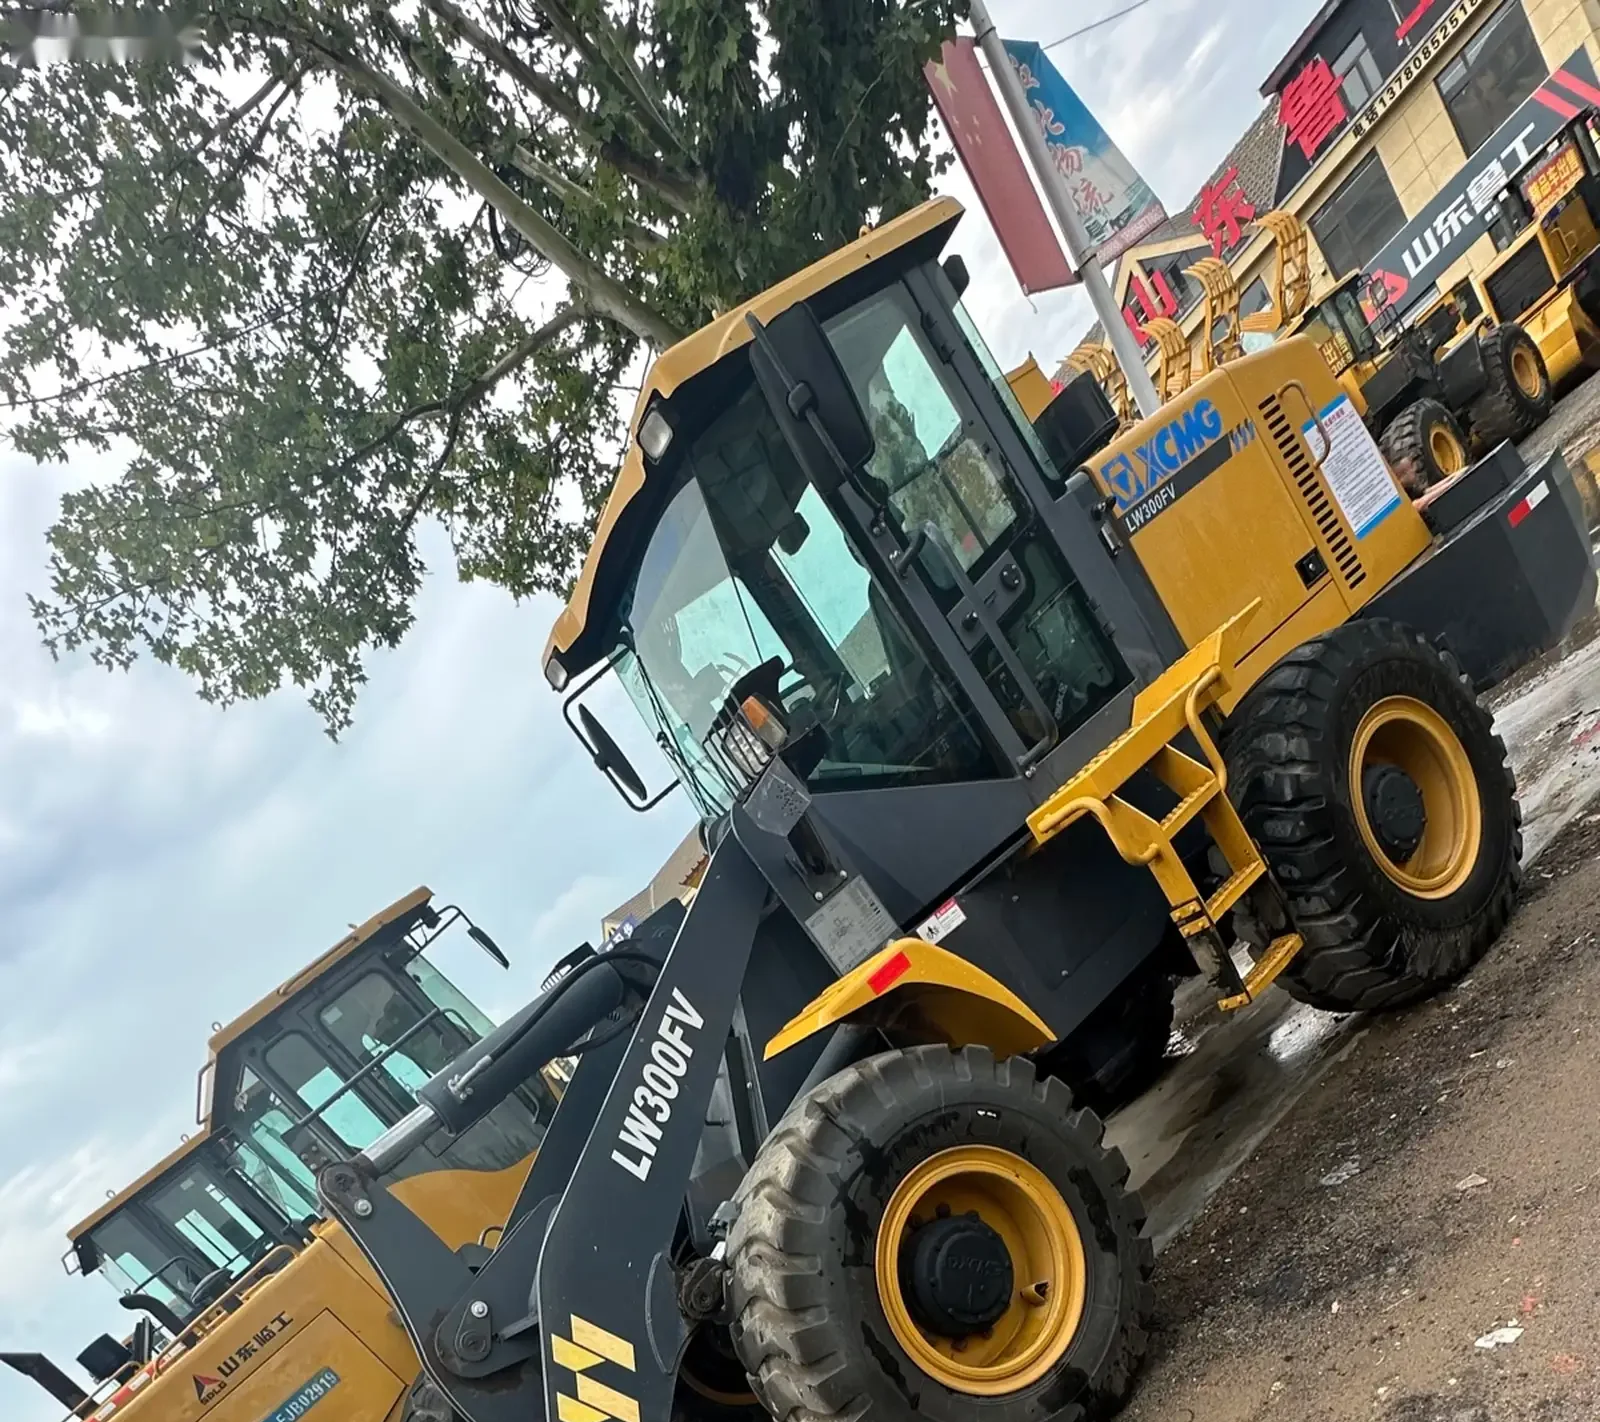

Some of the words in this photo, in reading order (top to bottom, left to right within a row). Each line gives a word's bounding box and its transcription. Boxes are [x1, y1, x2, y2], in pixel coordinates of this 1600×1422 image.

[1400, 122, 1543, 279] 山东鲁工
[1131, 398, 1223, 490] XCMG
[1124, 482, 1176, 533] LW300FV
[610, 986, 705, 1182] LW300FV
[216, 1310, 294, 1378] 山东临工
[200, 1380, 228, 1406] SDLG
